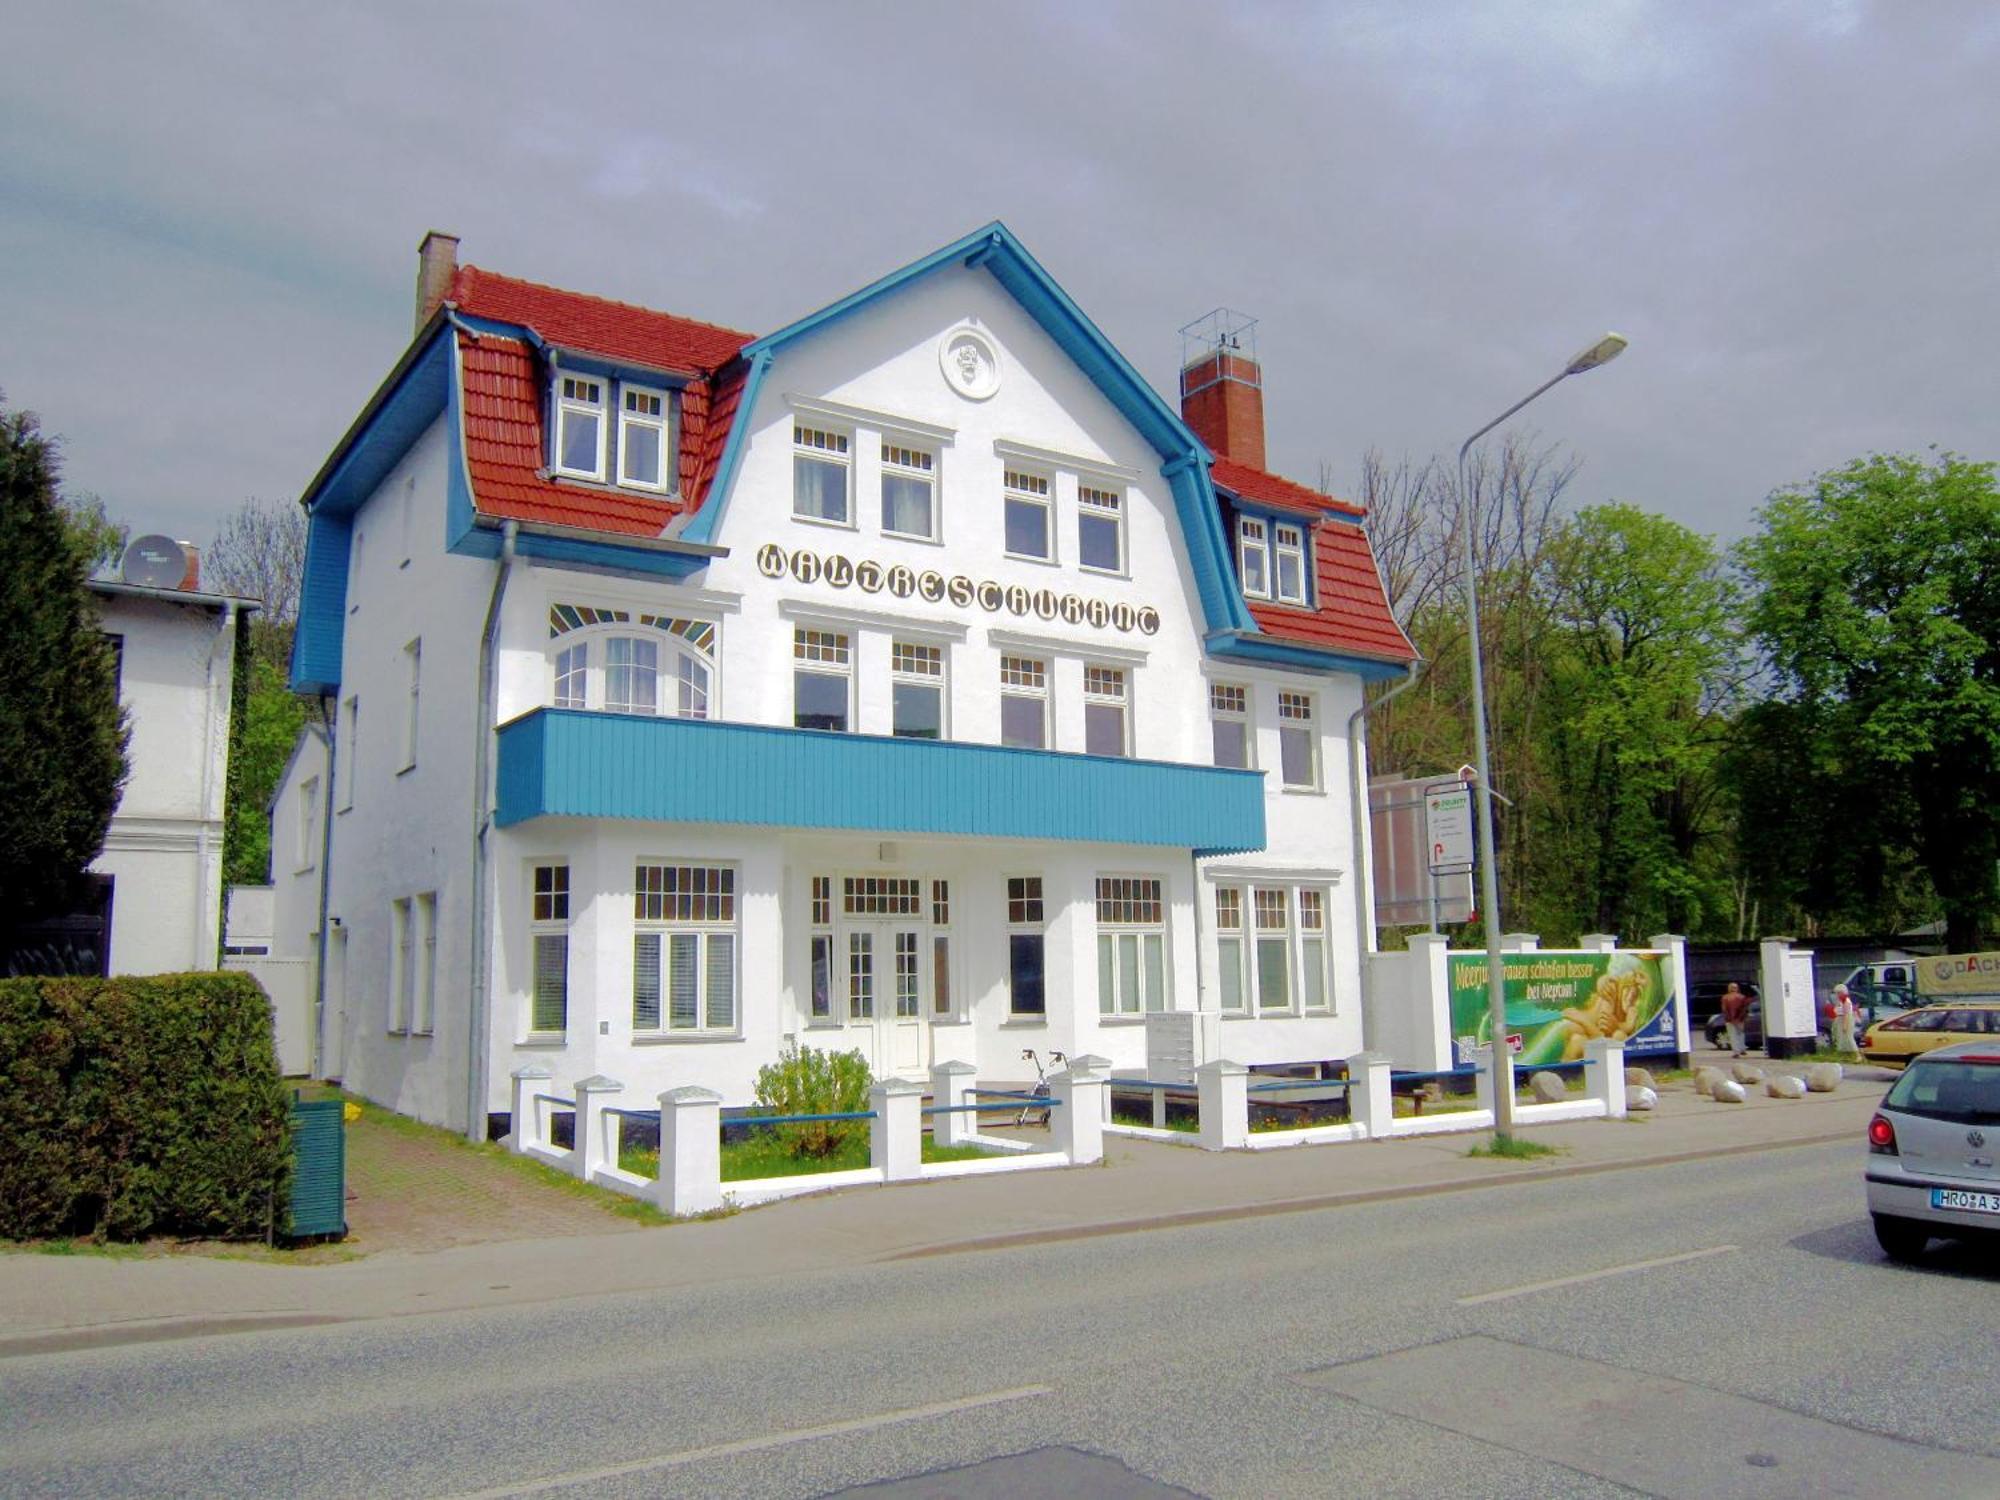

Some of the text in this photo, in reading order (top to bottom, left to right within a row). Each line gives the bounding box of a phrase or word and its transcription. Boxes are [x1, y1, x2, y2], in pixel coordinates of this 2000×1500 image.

[757, 543, 1160, 636] WALDRESTAURANT
[1455, 961, 1529, 991] Meerjurauen
[1530, 960, 1566, 980] schlafen
[1568, 960, 1594, 978] besser
[1526, 982, 1540, 1000] bei
